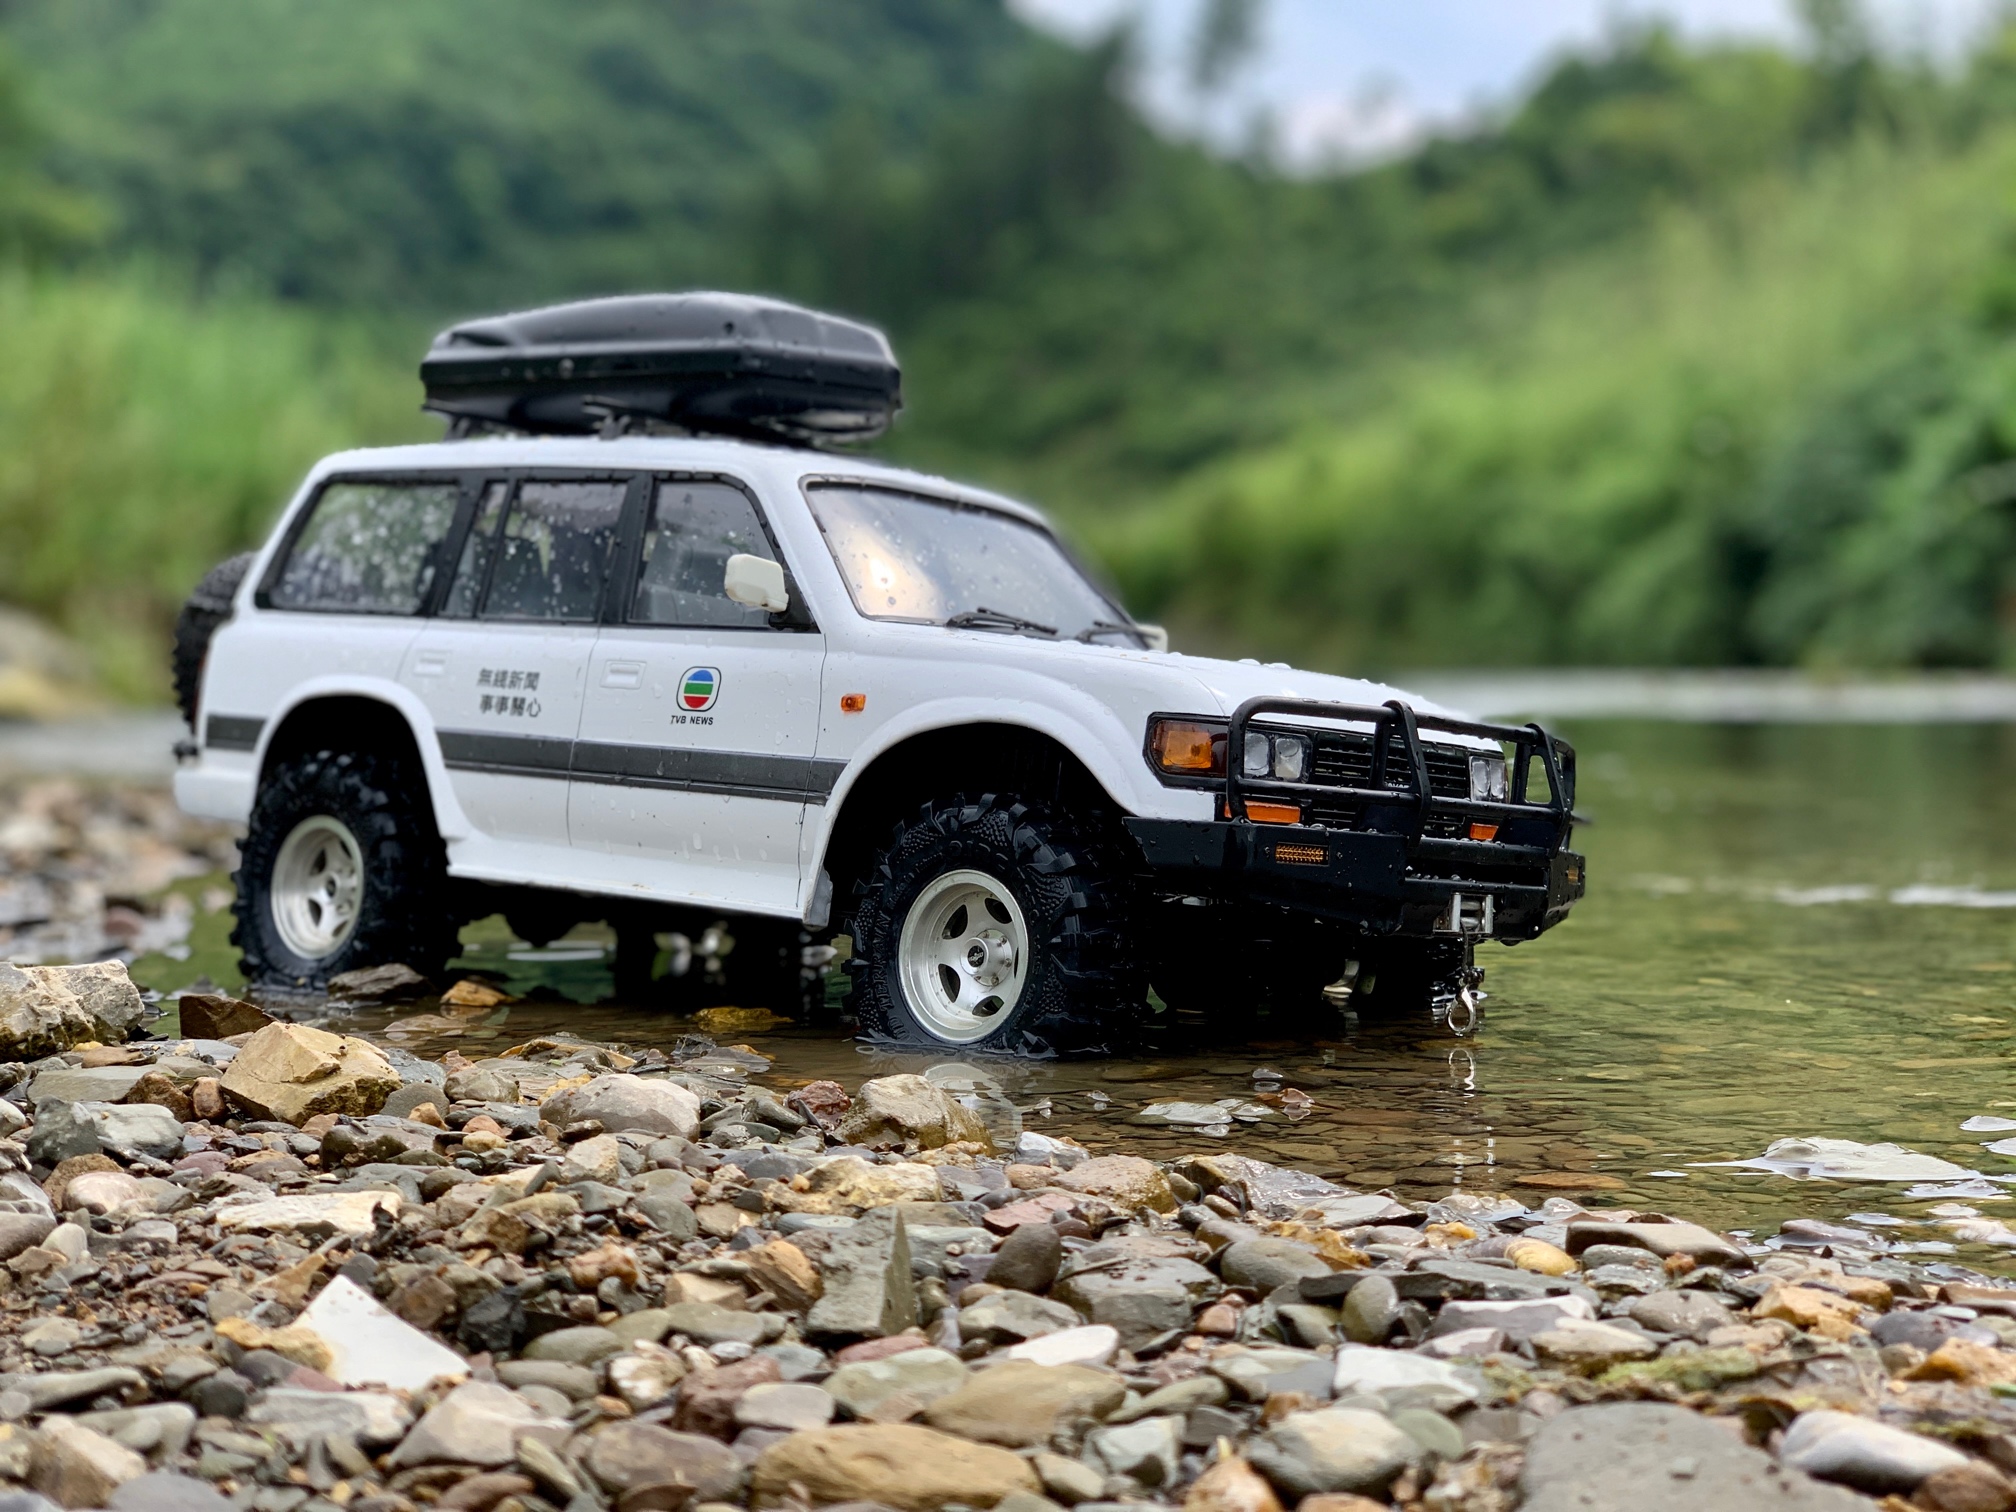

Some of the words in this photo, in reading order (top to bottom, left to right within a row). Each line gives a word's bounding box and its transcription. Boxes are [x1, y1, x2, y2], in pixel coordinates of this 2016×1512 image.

[670, 714, 687, 725] TVB
[690, 715, 714, 726] NEWS
[872, 910, 894, 1012] TERRAIN
